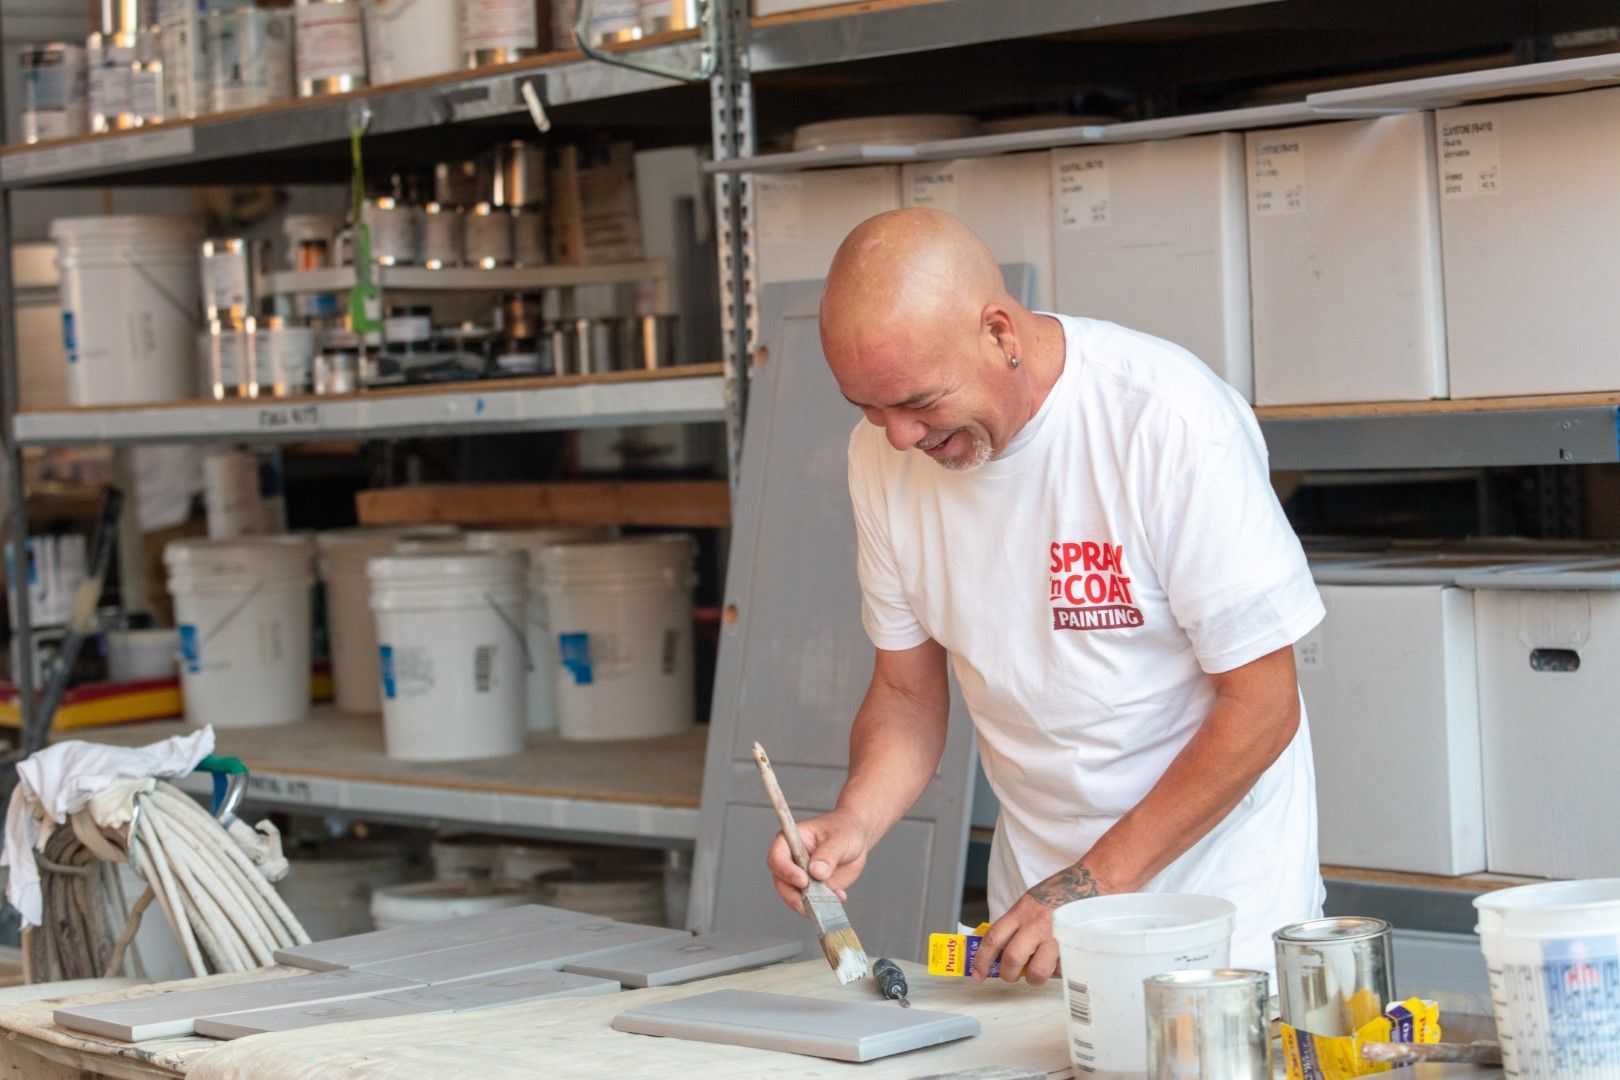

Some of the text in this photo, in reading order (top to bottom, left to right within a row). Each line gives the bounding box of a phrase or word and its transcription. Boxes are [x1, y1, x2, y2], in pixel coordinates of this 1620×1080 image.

[1050, 541, 1123, 574] SPRAY
[1064, 573, 1133, 605] COAT
[1058, 609, 1139, 627] PAINTING
[945, 938, 958, 972] Purdy
